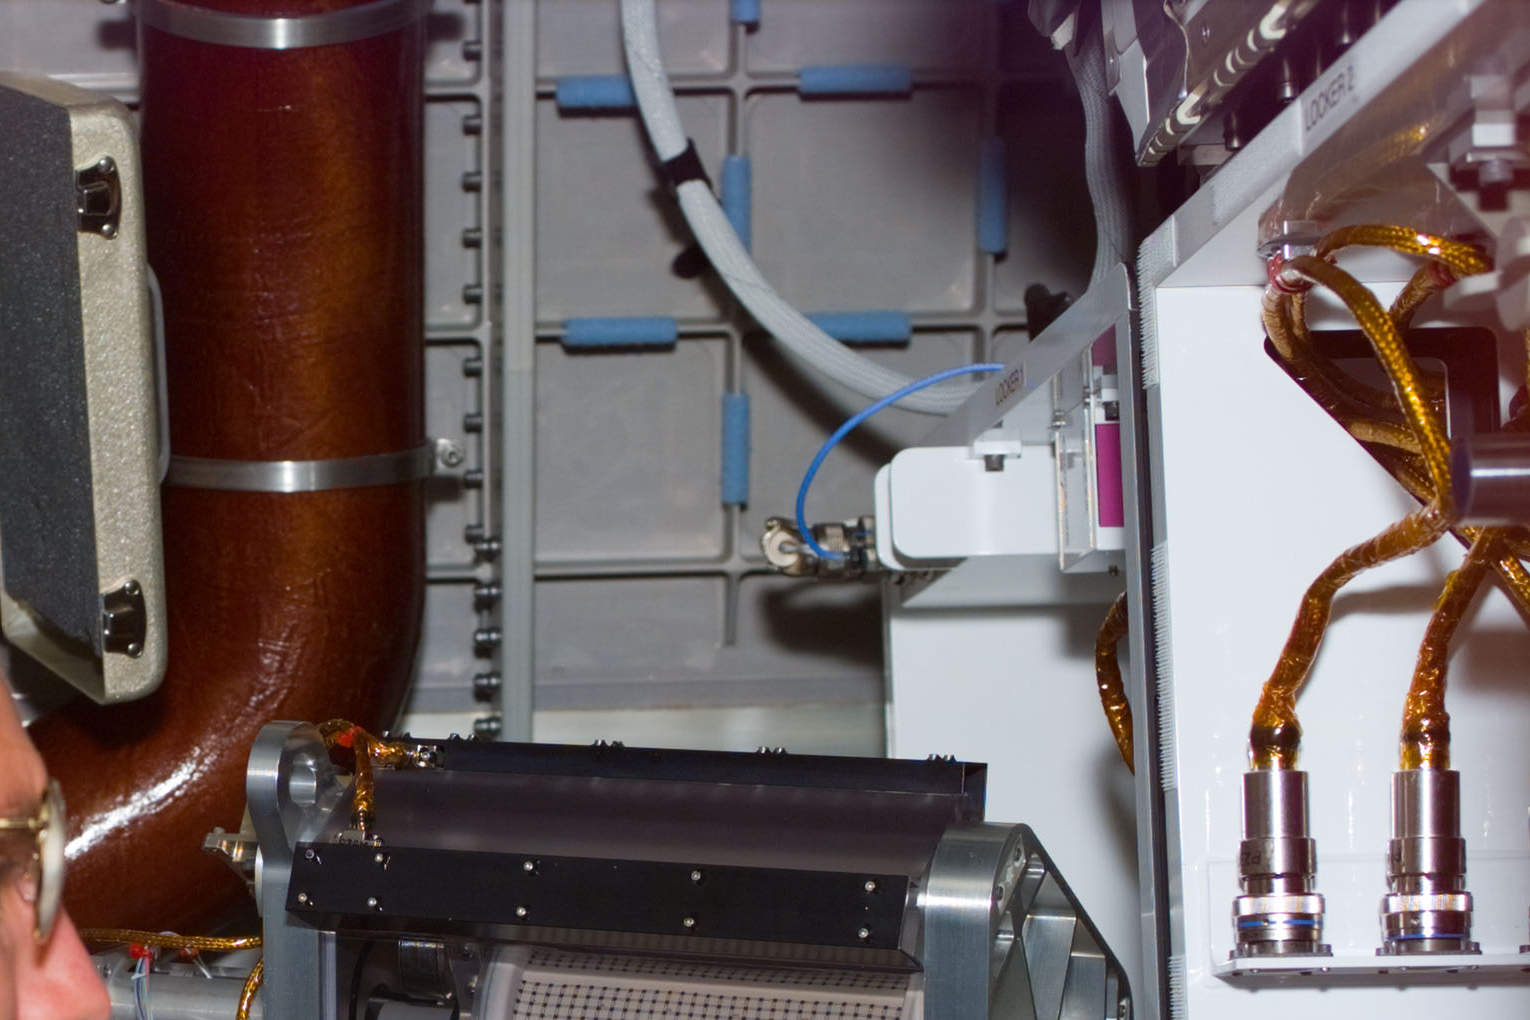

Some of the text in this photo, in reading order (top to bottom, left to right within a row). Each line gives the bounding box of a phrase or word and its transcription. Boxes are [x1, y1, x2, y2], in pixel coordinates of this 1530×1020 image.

[1304, 64, 1355, 132] LOCKER 2
[995, 368, 1020, 406] LOCKER
